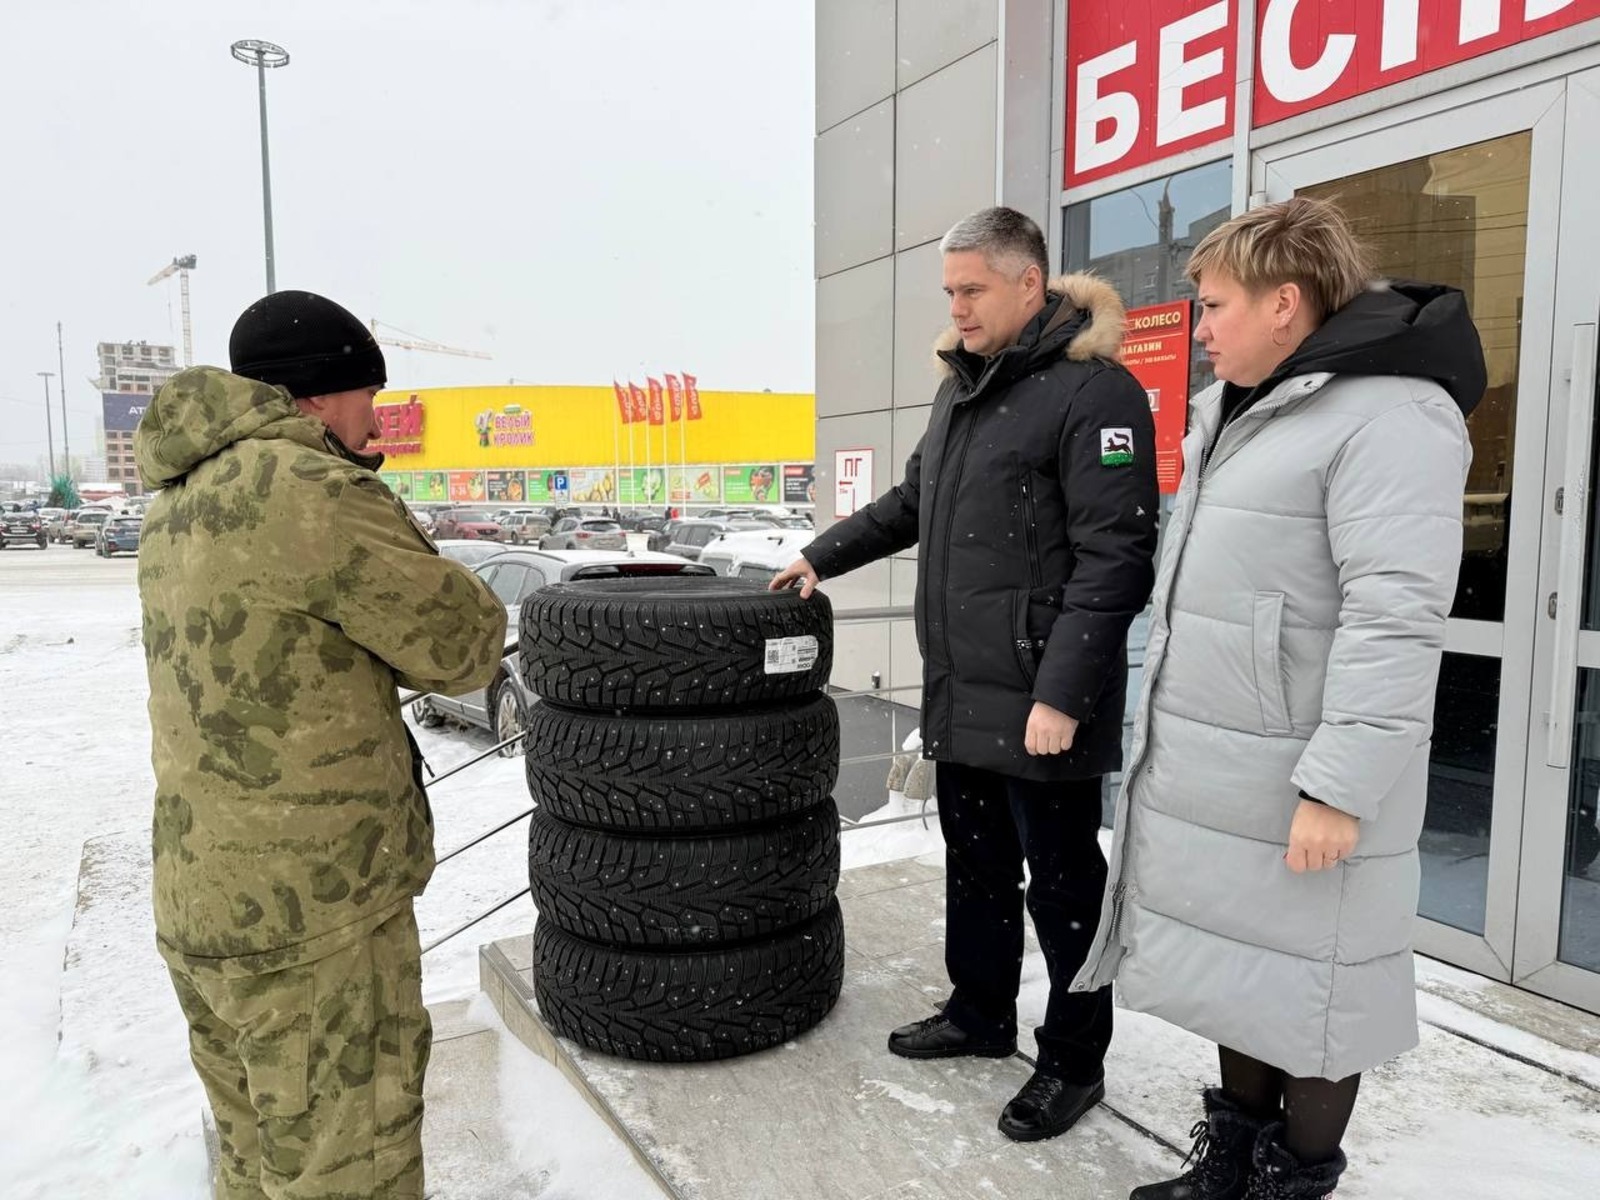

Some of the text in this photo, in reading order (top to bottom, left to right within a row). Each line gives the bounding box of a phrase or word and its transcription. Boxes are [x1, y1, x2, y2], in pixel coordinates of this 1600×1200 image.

[1074, 0, 1575, 174] БЕС
[1134, 311, 1181, 330] КОЛЕСО
[844, 457, 863, 478] ПГ
